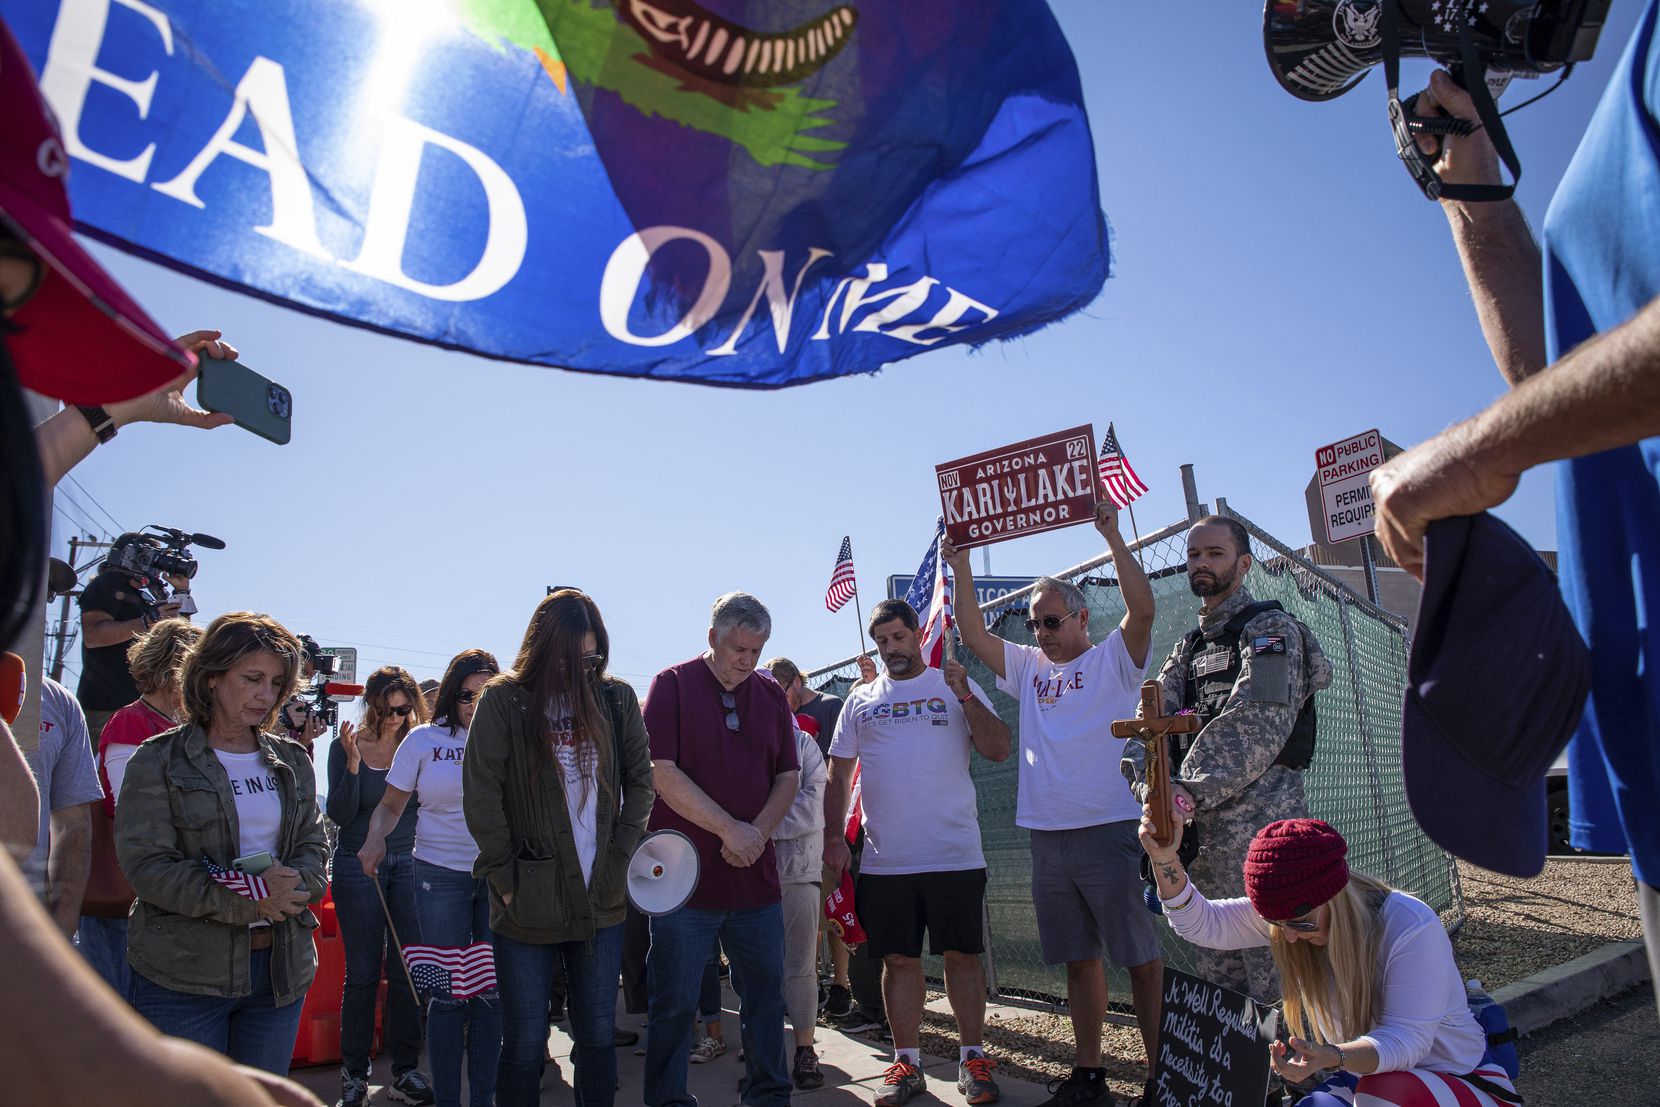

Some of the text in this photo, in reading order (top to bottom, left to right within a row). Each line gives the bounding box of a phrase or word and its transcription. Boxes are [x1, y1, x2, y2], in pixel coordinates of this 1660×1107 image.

[600, 225, 835, 356] ON
[811, 262, 999, 346] ME
[1068, 441, 1085, 458] 22
[1320, 435, 1377, 466] NO PUBLIC
[976, 452, 1047, 479] ARIZONA
[1323, 453, 1380, 481] PARKING
[940, 471, 959, 488] NOV
[942, 458, 1091, 525] KARI LAKE
[1335, 485, 1372, 508] PERMI
[968, 504, 1070, 538] GOVERNOR
[862, 697, 948, 723] LGBTQ
[879, 718, 893, 726] GET
[894, 716, 918, 724] BIDEN
[245, 776, 264, 794] IN
[842, 912, 855, 927] 45
[1182, 981, 1210, 1016] Well
[1208, 989, 1258, 1043] Regulated
[1222, 1052, 1231, 1071] a
[1208, 1074, 1224, 1104] to
[1224, 1090, 1233, 1107] a
